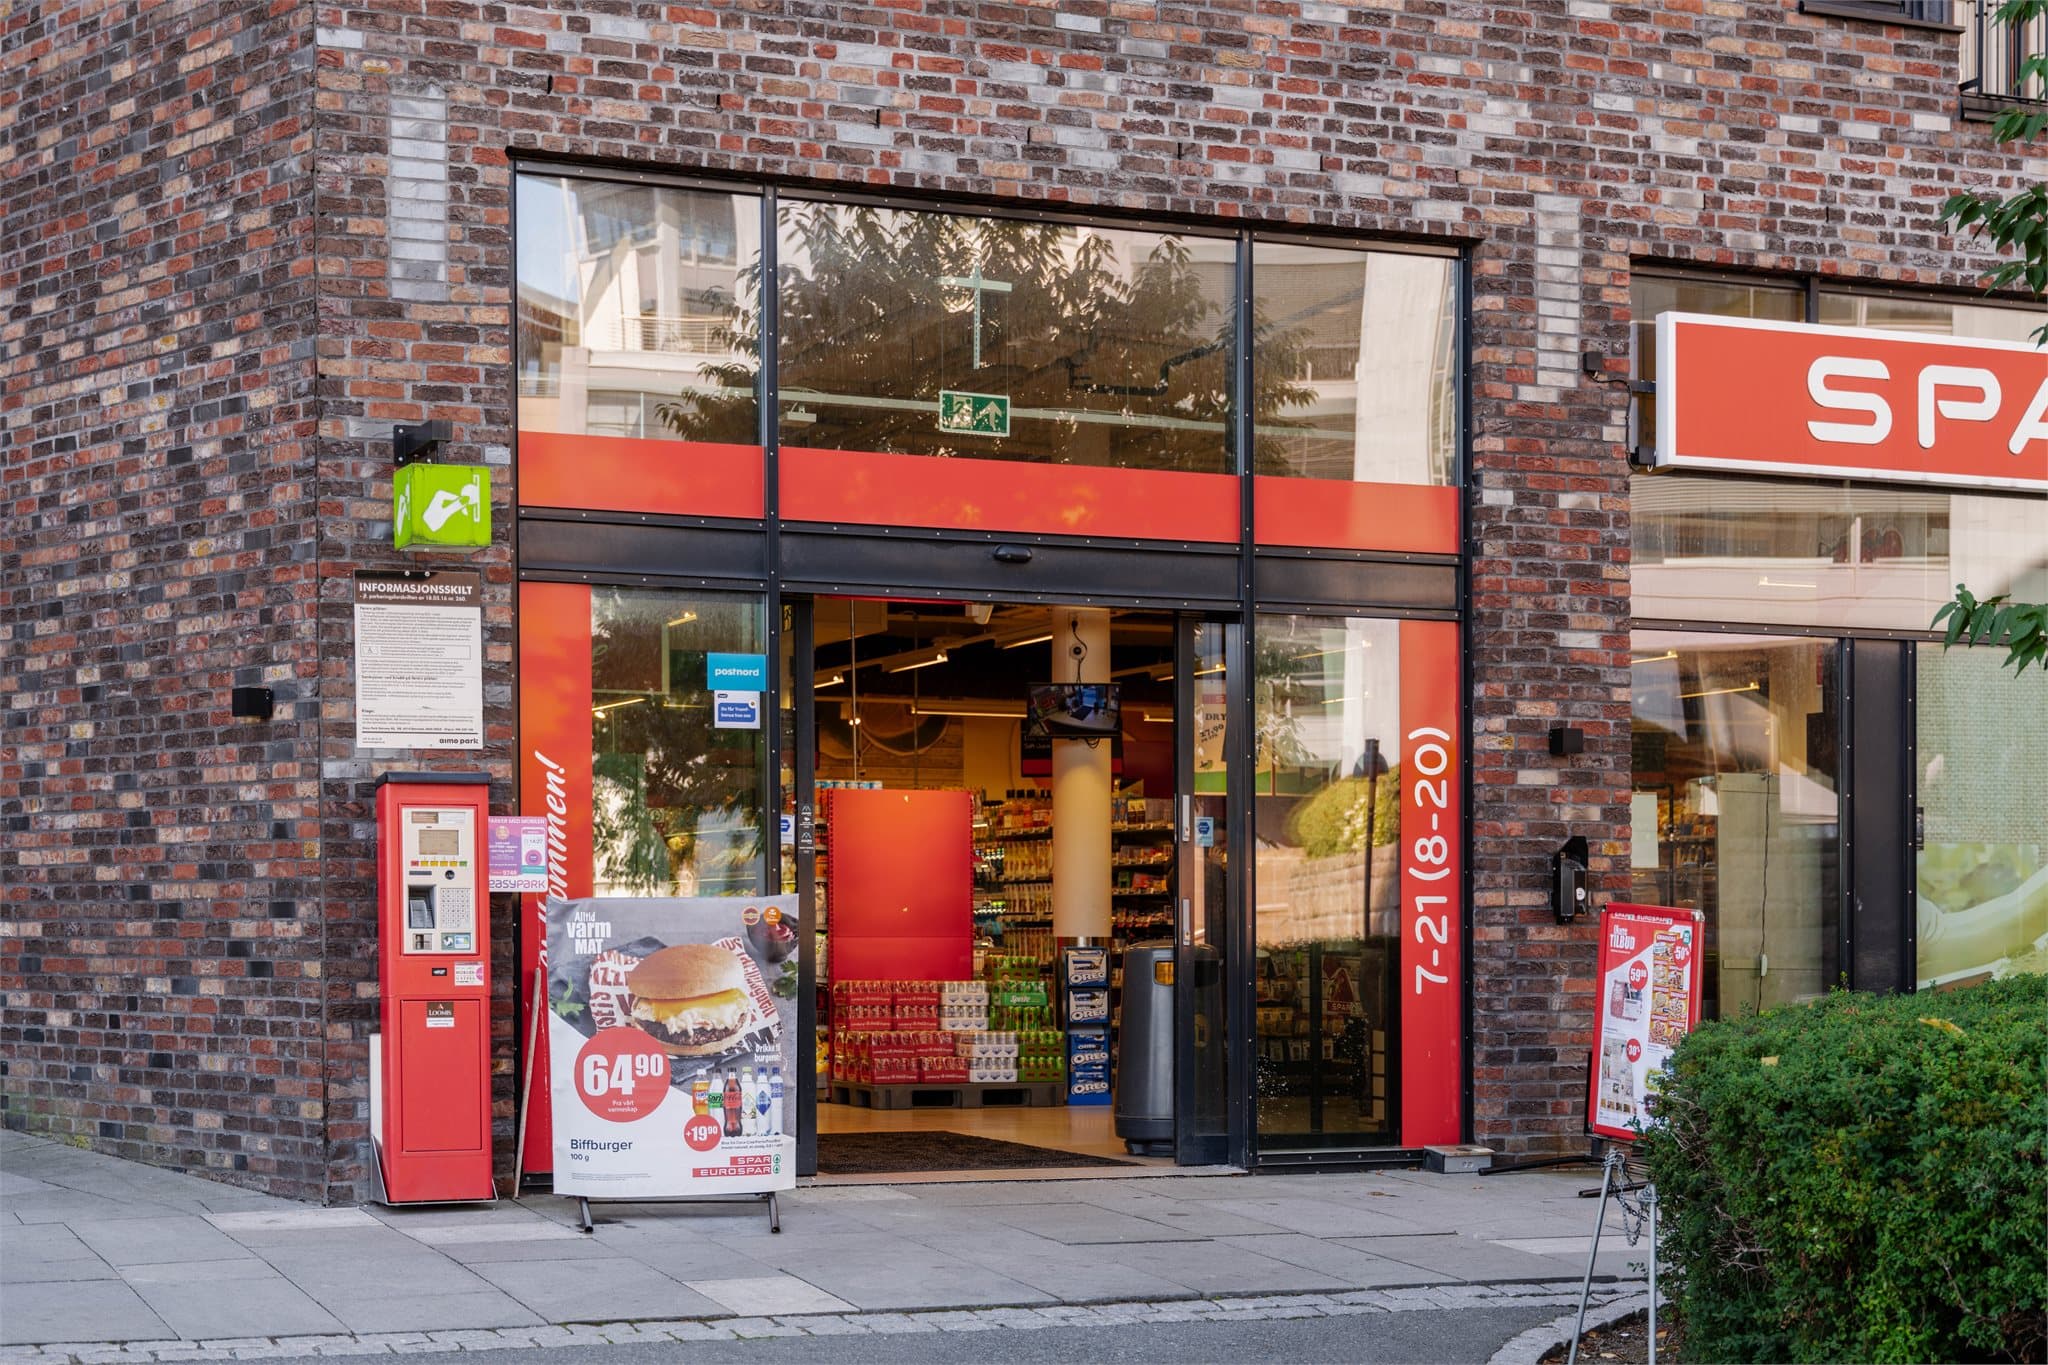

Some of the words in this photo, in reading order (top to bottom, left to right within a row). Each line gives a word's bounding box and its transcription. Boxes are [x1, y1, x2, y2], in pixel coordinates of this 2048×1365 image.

[359, 582, 473, 595] INFORMASJONSSKILT
[714, 668, 759, 677] postnord
[1408, 727, 1450, 881] (8-20)
[574, 911, 596, 922] Alltid
[566, 921, 612, 938] varm
[574, 938, 604, 955] MAT
[1415, 896, 1449, 994] 7-21
[1610, 933, 1636, 950] TILBUD
[1070, 972, 1105, 984] OREO
[1071, 1009, 1105, 1021] OREO
[1071, 1052, 1109, 1065] OREO
[1071, 1082, 1109, 1095] OREO
[570, 1139, 633, 1152] Biffburger
[570, 1153, 583, 1161] 100
[737, 1156, 771, 1165] SPAR
[700, 1166, 771, 1176] EUROSPAR
